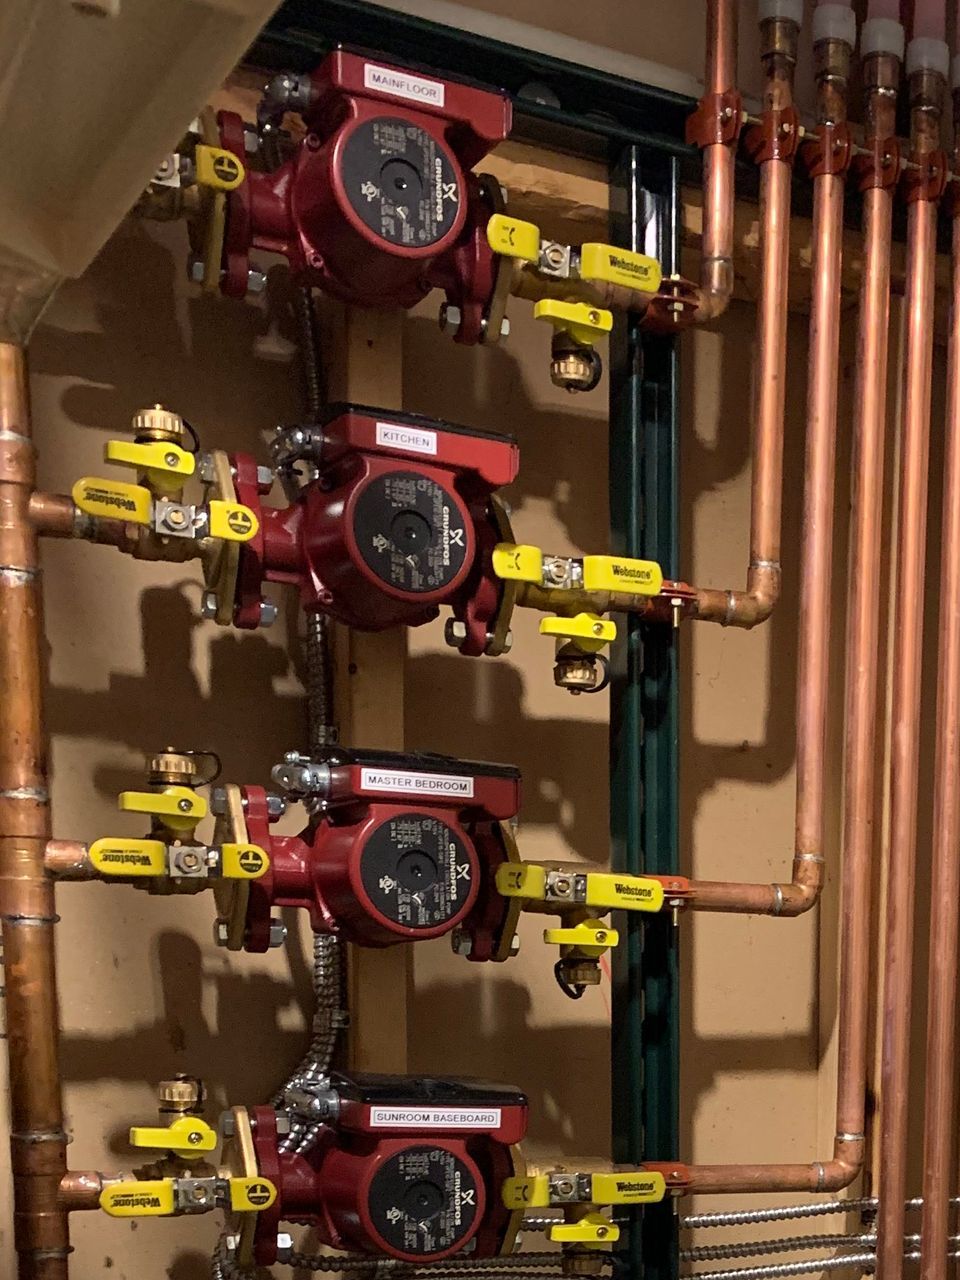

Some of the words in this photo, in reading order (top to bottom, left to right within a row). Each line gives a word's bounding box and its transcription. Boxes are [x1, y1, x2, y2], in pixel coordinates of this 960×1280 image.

[372, 73, 437, 98] MAINFLOOR
[435, 157, 443, 222] GRUNDFOS
[608, 255, 650, 276] Webstone
[383, 431, 430, 447] KITCHEN
[612, 564, 652, 580] Webstone
[368, 776, 412, 787] MASTER
[415, 779, 468, 791] BEDROOM
[102, 853, 151, 866] Webstone
[449, 843, 458, 900] GRUNDFOS
[615, 883, 653, 897] Webstone
[377, 1113, 430, 1122] SUNROOM
[433, 1114, 495, 1123] BASEBOARD
[615, 1181, 654, 1193] Webstone
[111, 1197, 161, 1209] Webstone
[454, 1171, 462, 1225] GRUNDFOS
